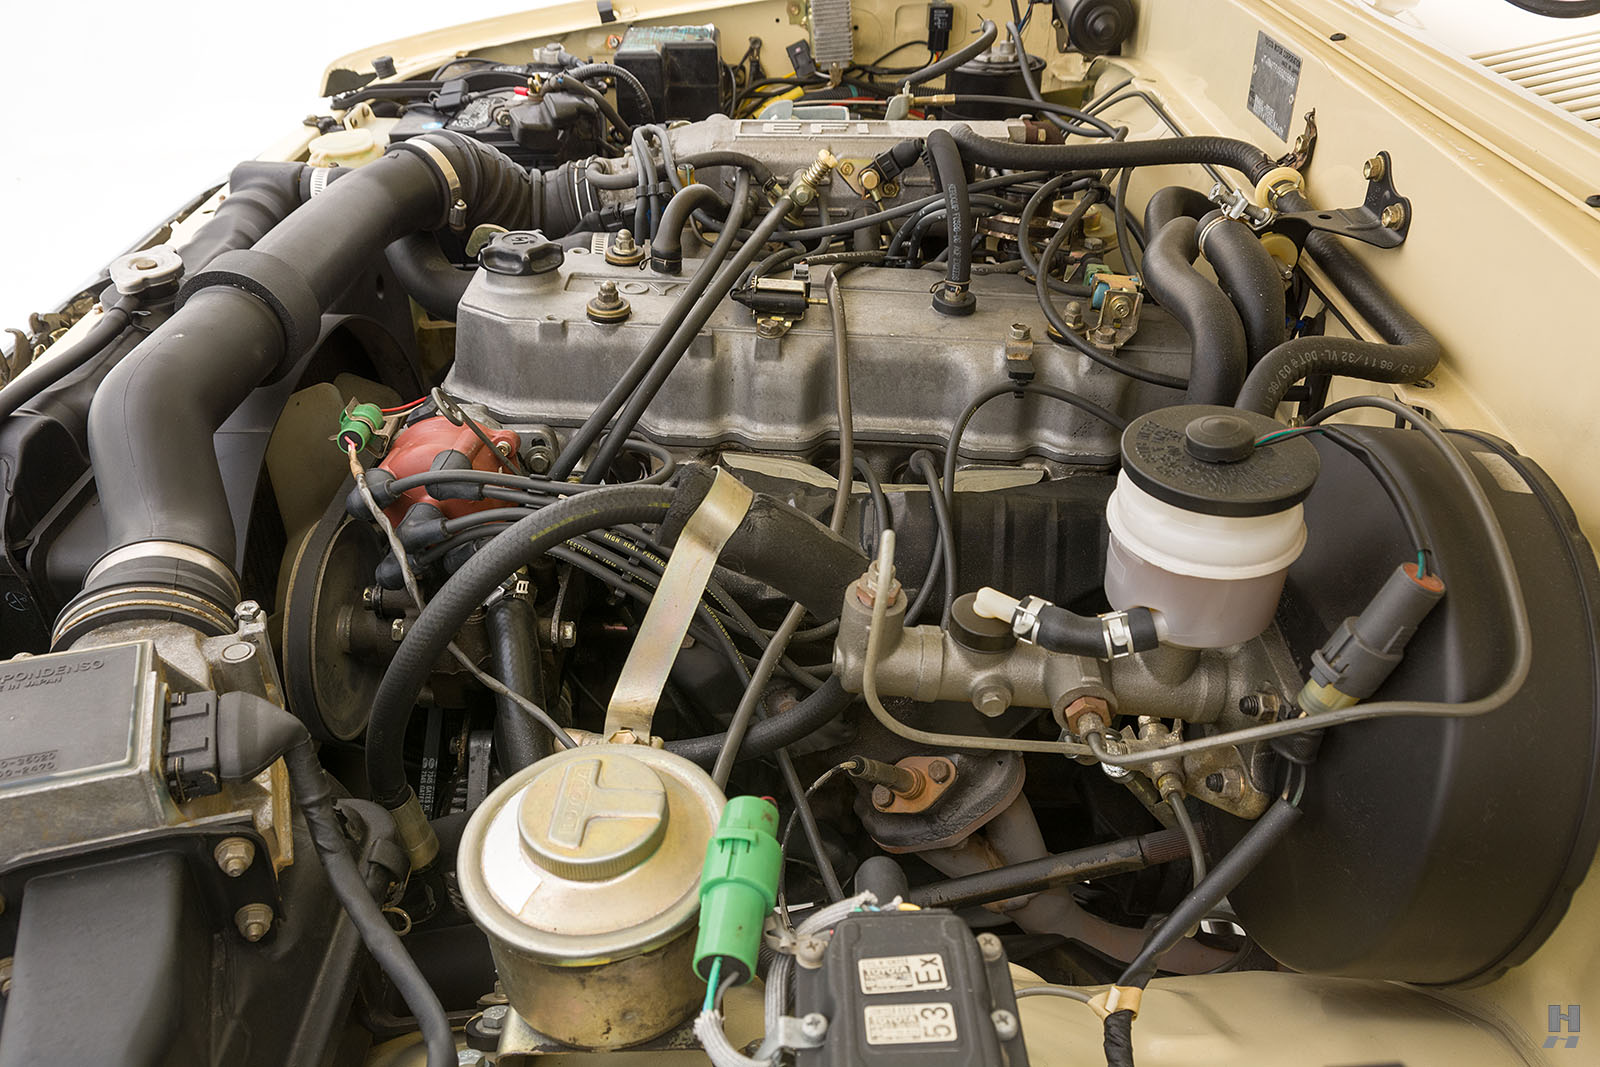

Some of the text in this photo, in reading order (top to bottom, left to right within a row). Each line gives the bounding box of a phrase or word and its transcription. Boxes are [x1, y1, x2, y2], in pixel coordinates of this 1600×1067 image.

[762, 122, 870, 135] EFI
[604, 532, 620, 545] HIGH
[565, 539, 592, 556] TECTION
[0, 660, 105, 685] PONDENSO
[8, 683, 20, 691] IN
[24, 676, 63, 689] JAPAN
[915, 957, 943, 984] EX
[920, 1006, 952, 1038] 53
